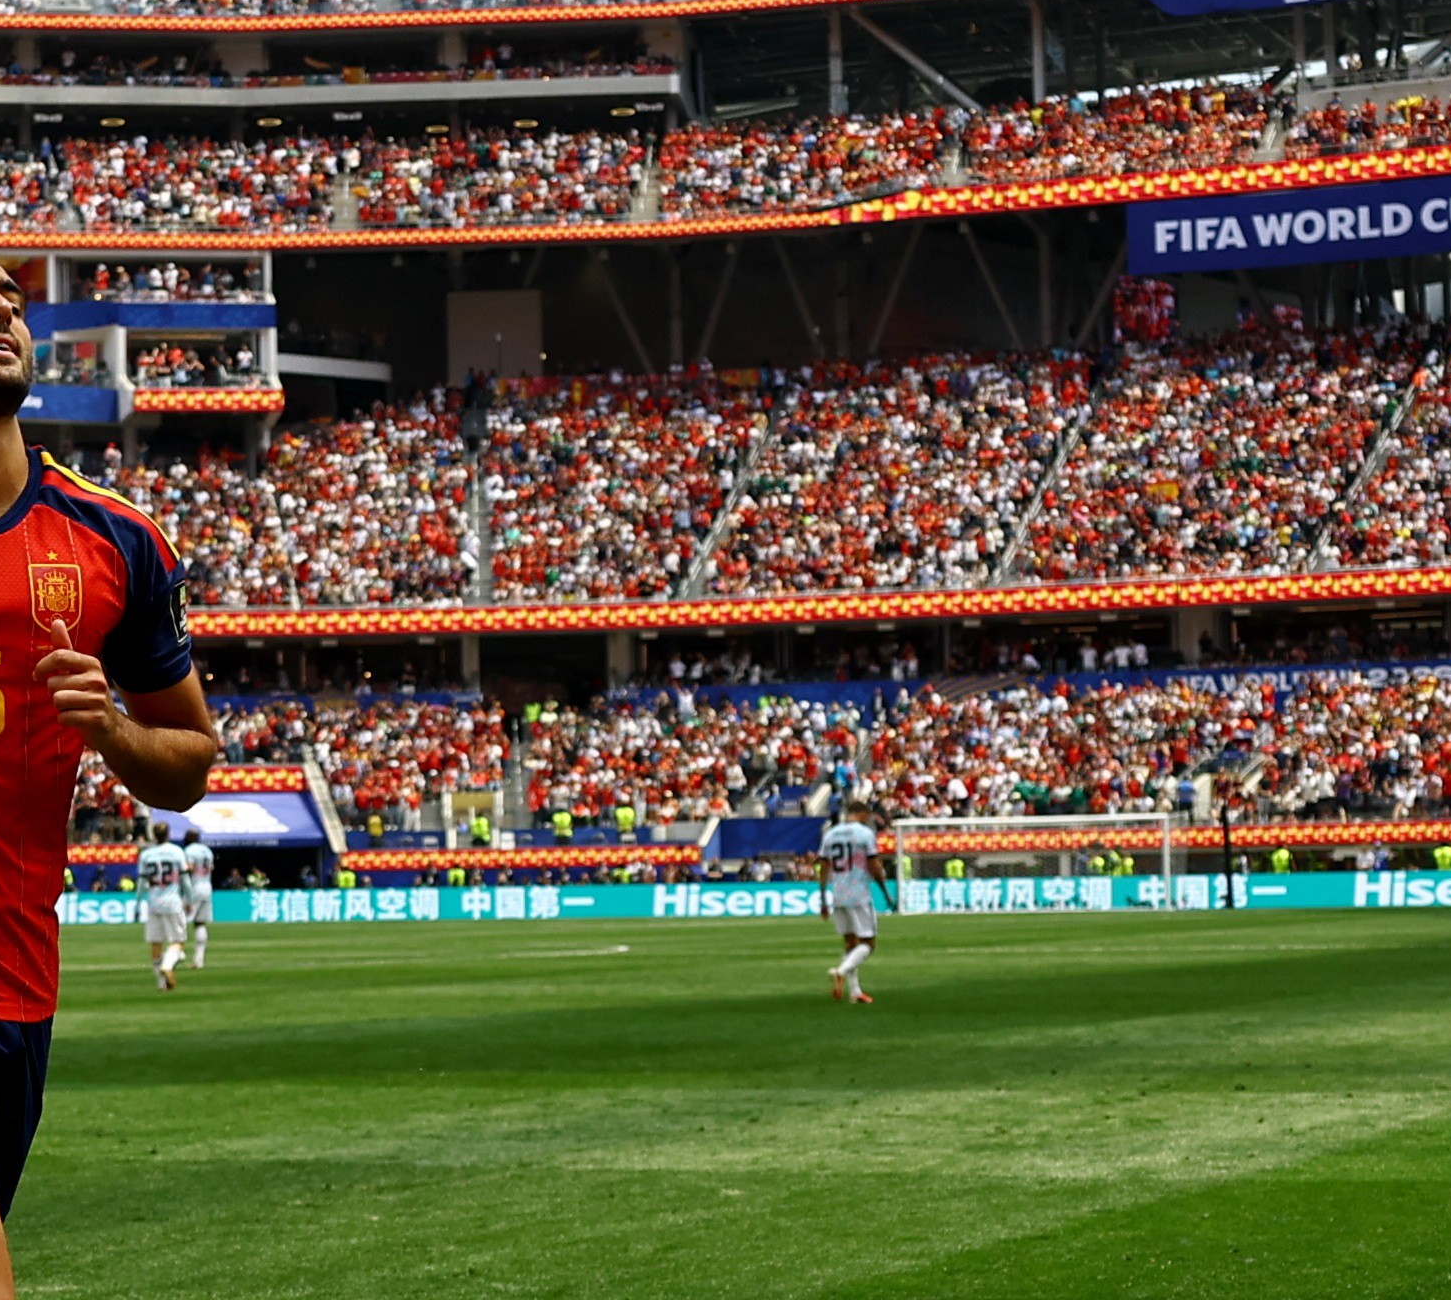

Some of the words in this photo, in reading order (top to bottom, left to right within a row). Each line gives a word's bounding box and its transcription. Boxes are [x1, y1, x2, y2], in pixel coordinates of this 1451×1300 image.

[1154, 216, 1246, 254] FIFA
[1252, 202, 1413, 248] WORLD
[147, 862, 173, 886] 22
[832, 842, 852, 872] 21
[250, 887, 440, 923] 海信新风空调
[460, 886, 595, 921] 中国第一
[653, 884, 834, 918] Hisense
